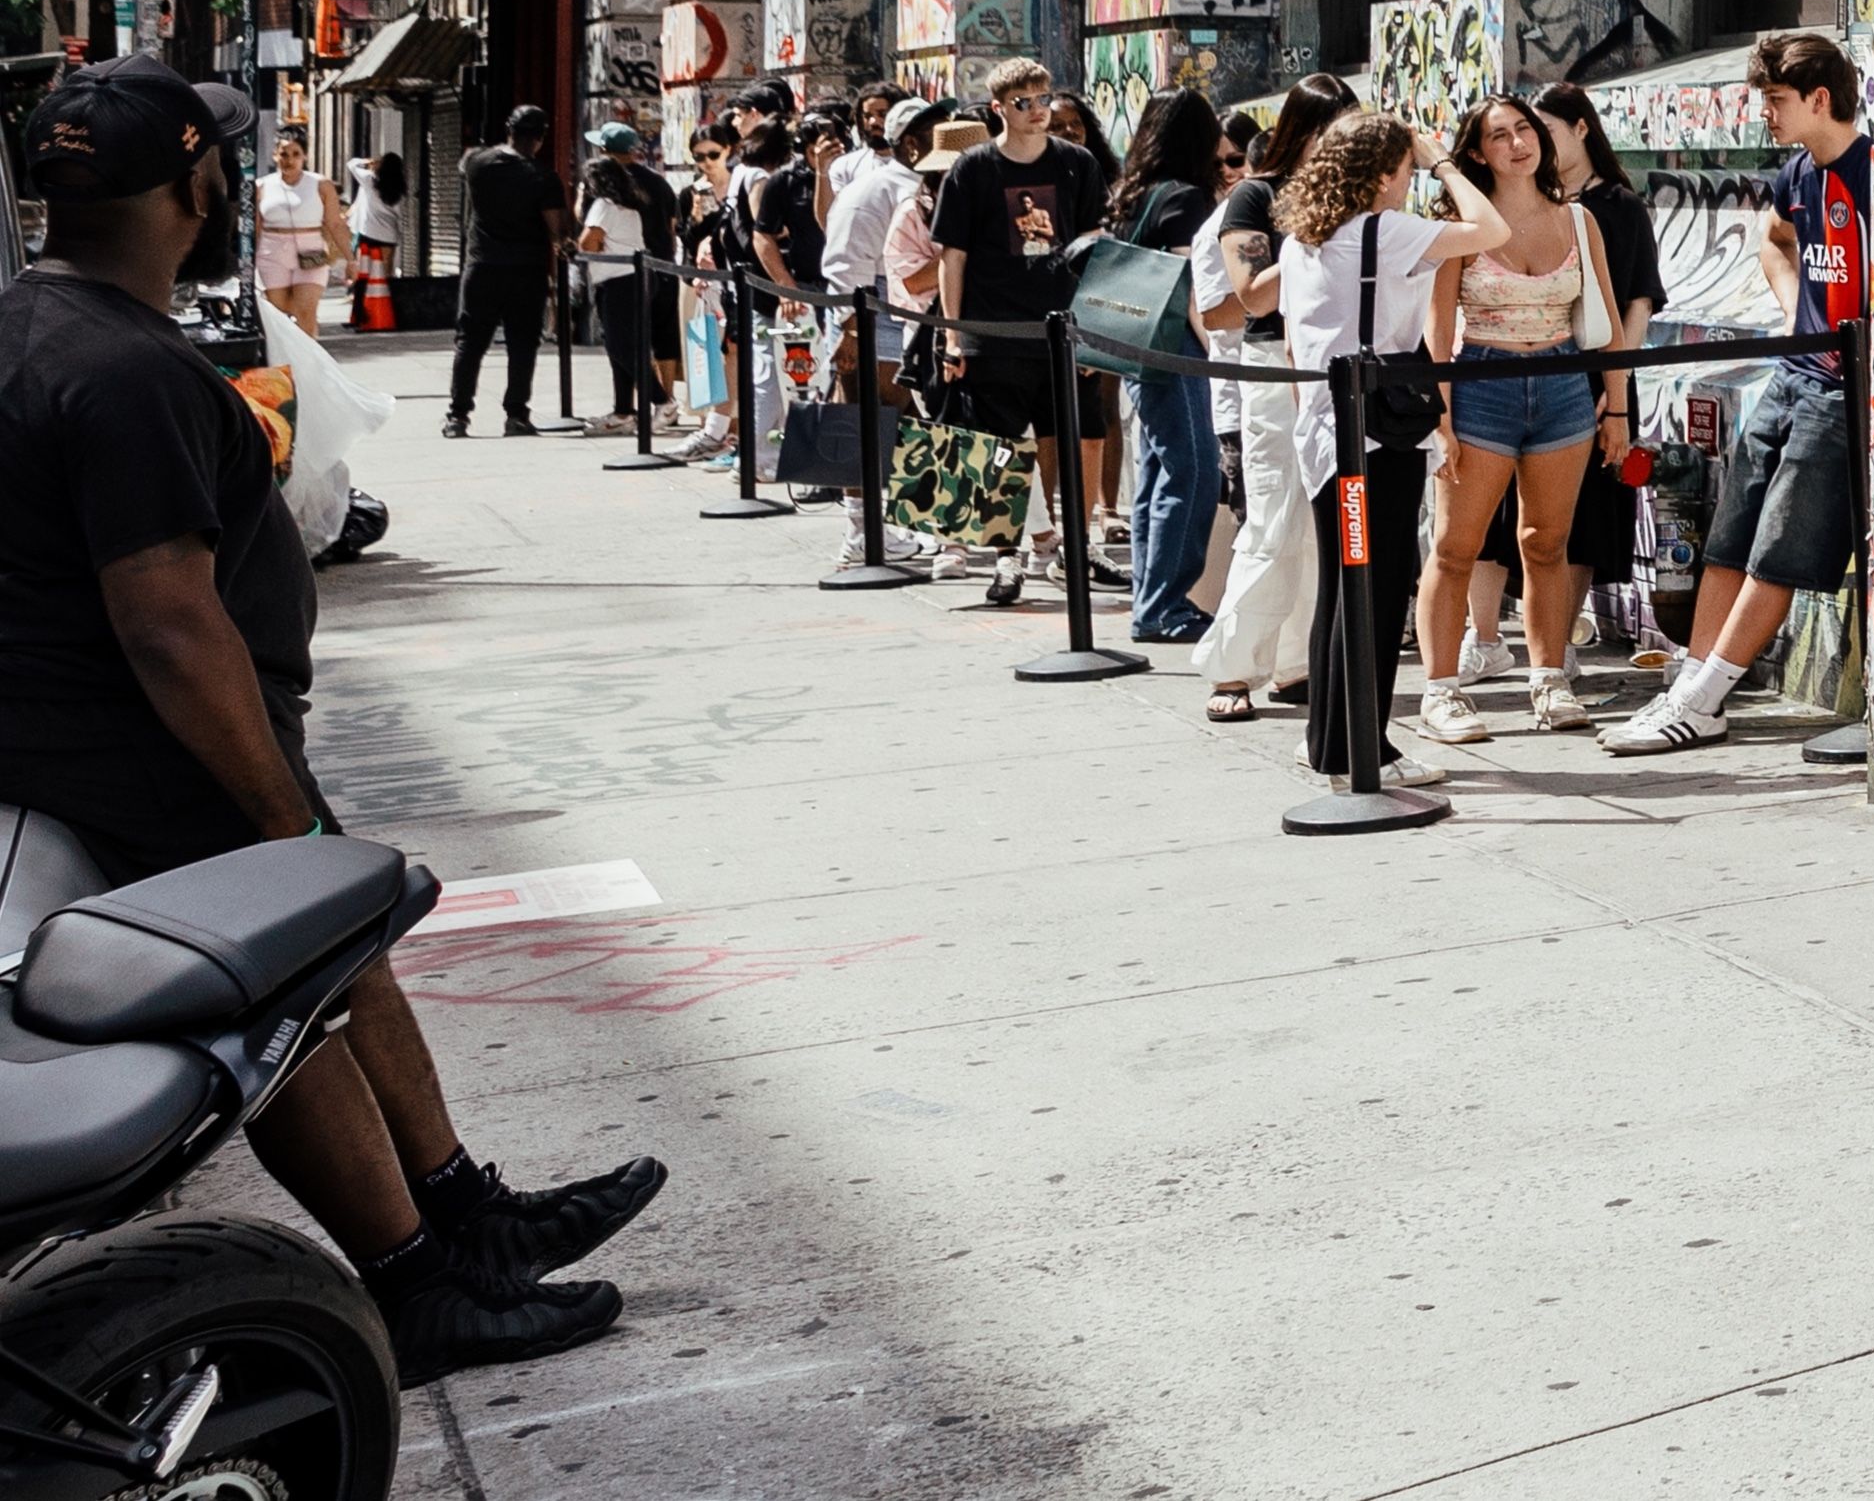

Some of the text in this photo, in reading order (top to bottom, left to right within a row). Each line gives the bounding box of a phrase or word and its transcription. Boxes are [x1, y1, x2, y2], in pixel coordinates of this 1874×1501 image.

[1802, 243, 1847, 268] ATAR
[1808, 266, 1848, 283] IRWAYS
[1344, 479, 1367, 563] Supreme
[259, 1016, 302, 1067] YAMAHA
